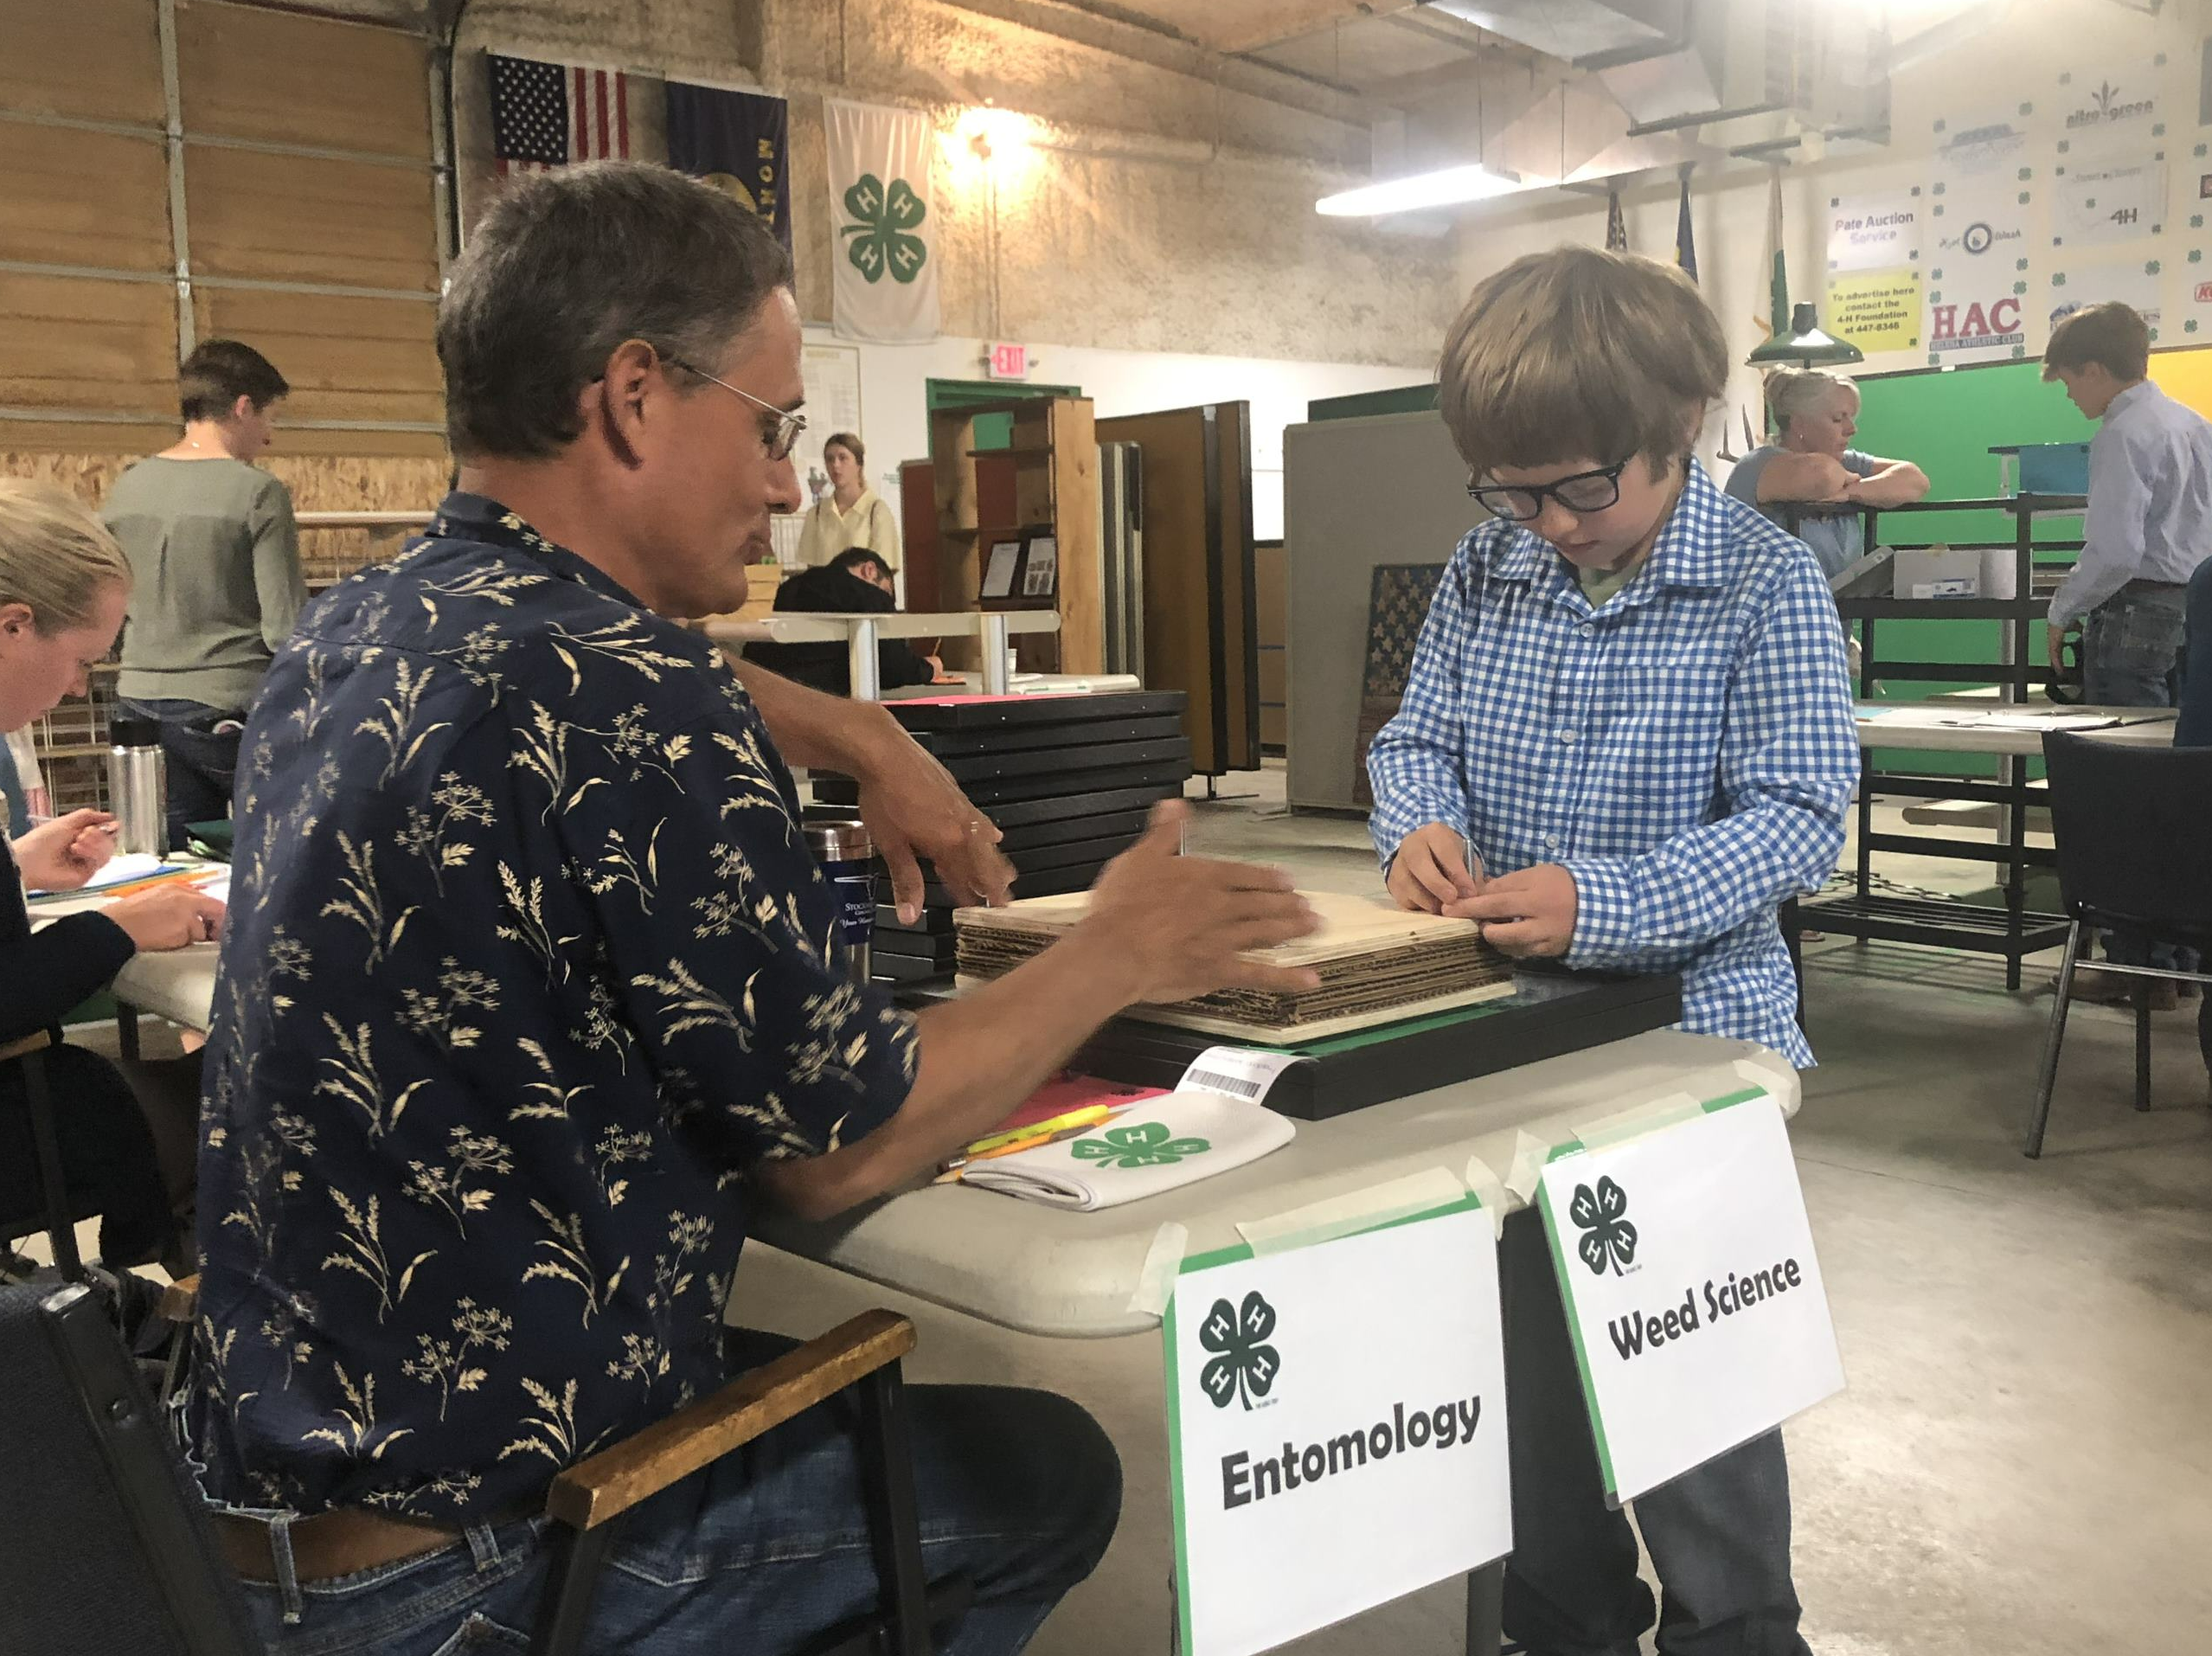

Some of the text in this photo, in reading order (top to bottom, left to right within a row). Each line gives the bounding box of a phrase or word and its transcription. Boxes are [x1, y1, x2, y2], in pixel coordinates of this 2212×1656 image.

[1866, 213, 1914, 228] Auction
[2109, 208, 2138, 225] 4H
[1850, 230, 1897, 245] Service
[1832, 286, 1915, 302] To advertise here
[1845, 299, 1900, 312] contact the
[1837, 311, 1908, 324] 4-H Foundation
[1932, 298, 2023, 340] HAC
[997, 346, 1024, 375] EXIT
[1576, 1196, 1593, 1219] H
[1604, 1187, 1619, 1210] H
[1586, 1239, 1602, 1263] H
[1616, 1229, 1632, 1251] H
[1247, 1305, 1266, 1333] H
[1607, 1255, 1802, 1362] Weed Science
[1209, 1313, 1230, 1342] H
[1209, 1365, 1231, 1395] H
[1252, 1355, 1273, 1382] H
[1221, 1393, 1482, 1511] Entomology
